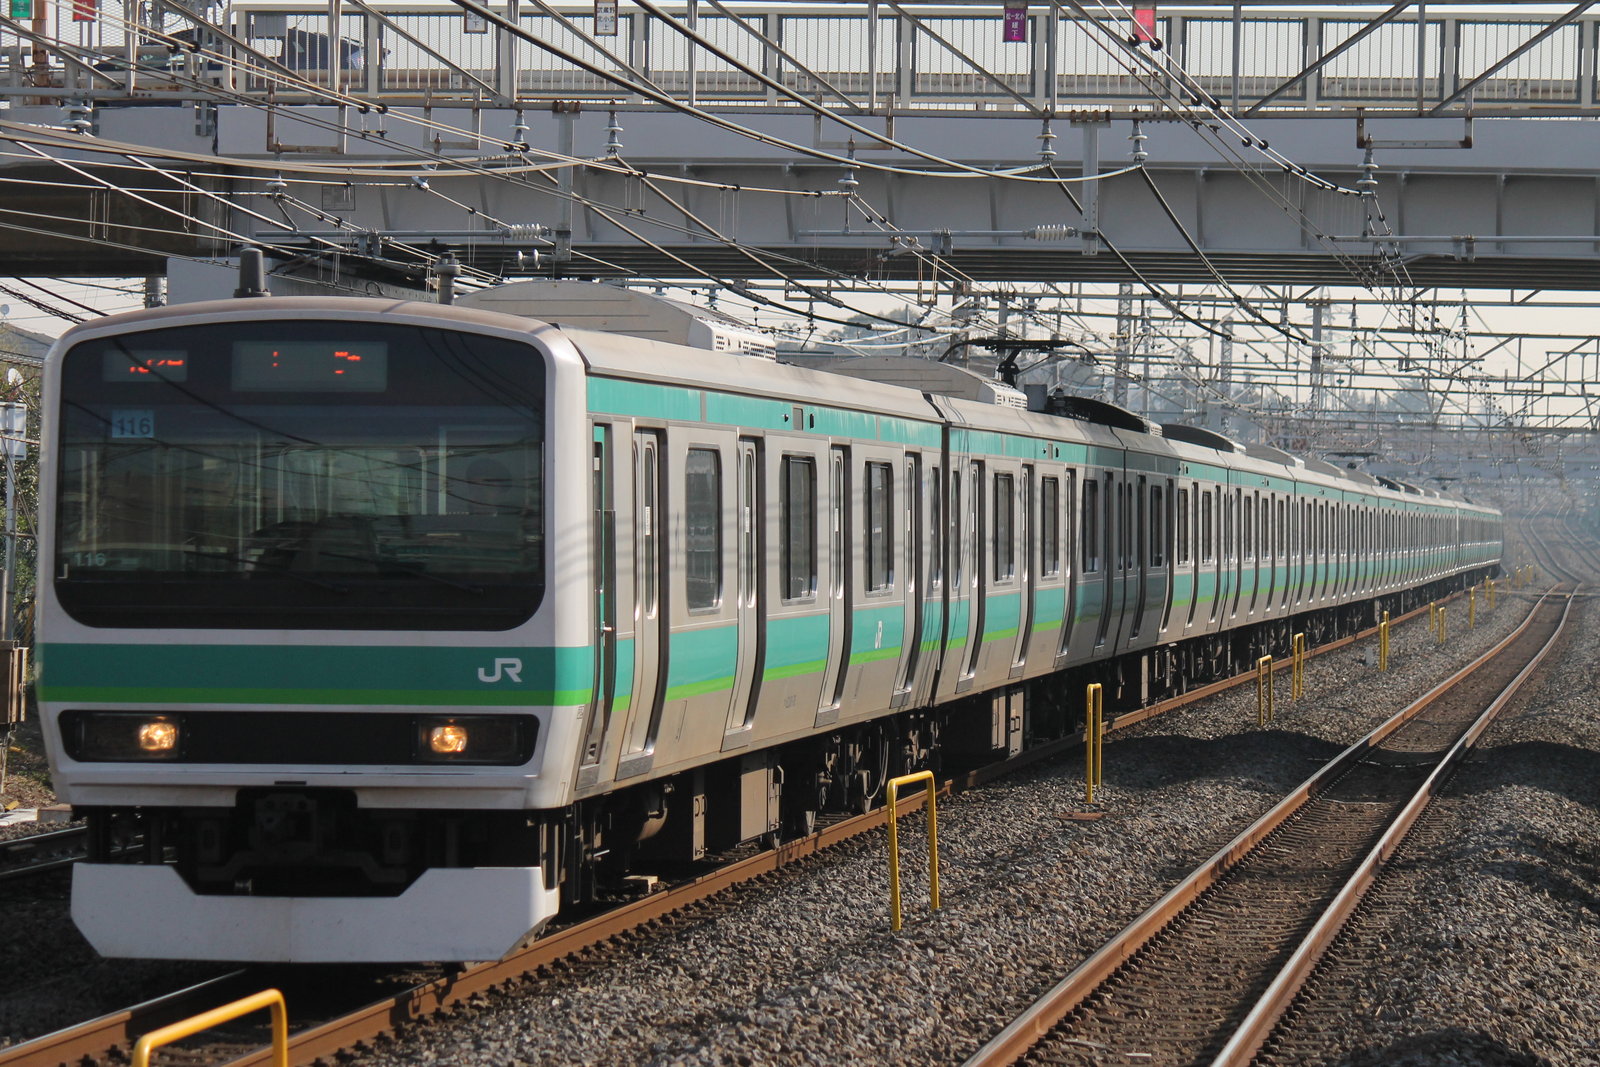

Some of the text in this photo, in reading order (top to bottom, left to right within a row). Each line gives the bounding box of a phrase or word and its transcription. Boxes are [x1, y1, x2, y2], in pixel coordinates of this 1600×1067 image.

[116, 418, 152, 435] 116
[74, 552, 106, 567] 116
[478, 657, 523, 683] JR
